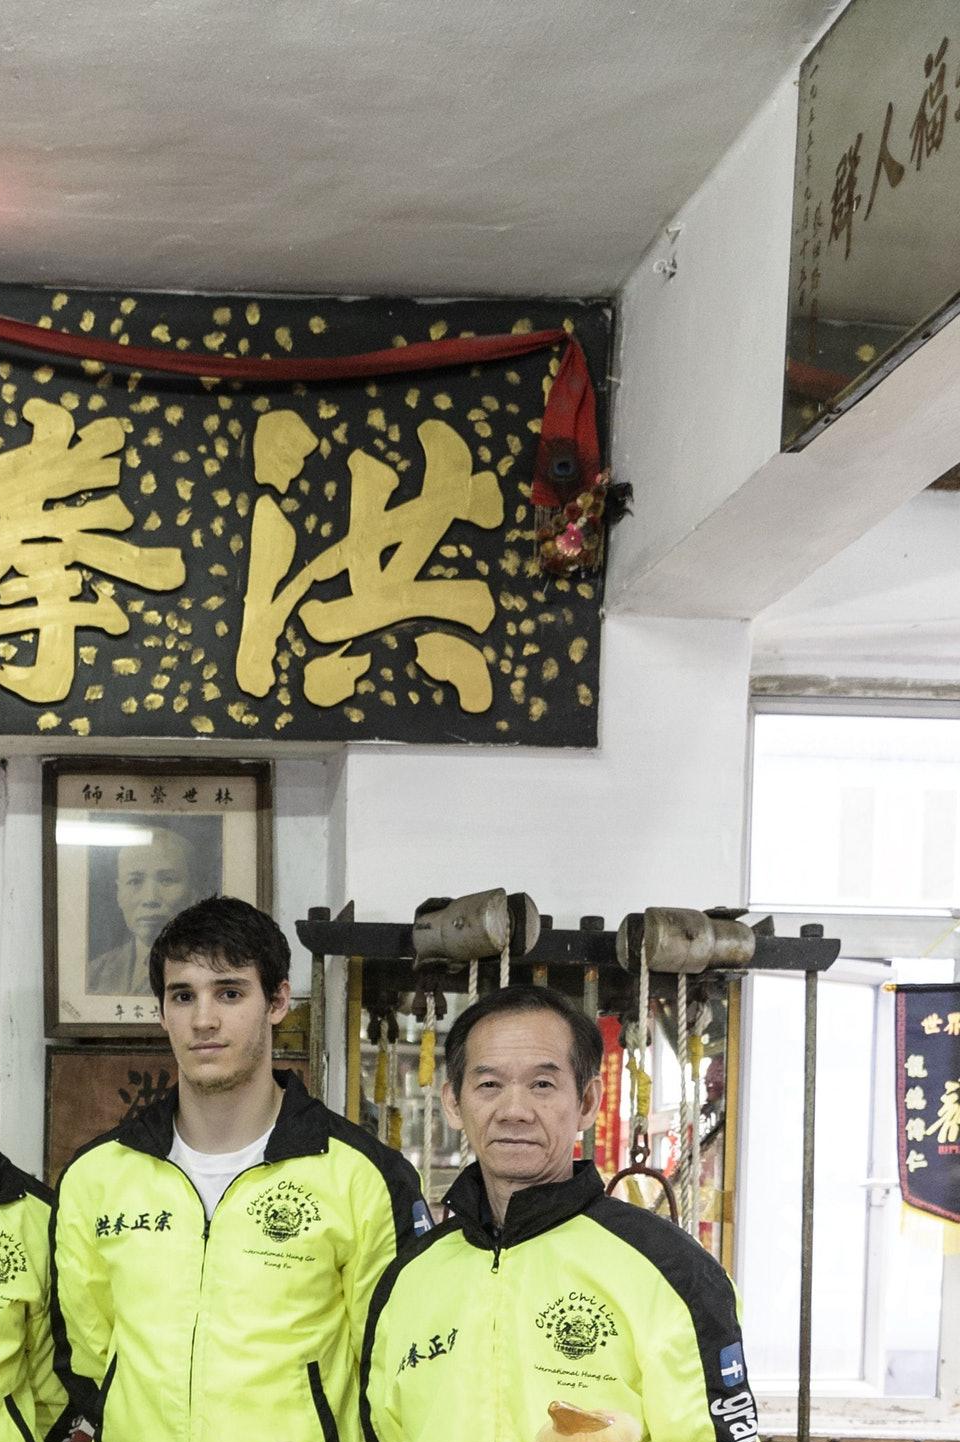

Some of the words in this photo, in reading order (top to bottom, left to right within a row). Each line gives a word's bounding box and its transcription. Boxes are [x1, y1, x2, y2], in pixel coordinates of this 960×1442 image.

[246, 1187, 273, 1215] Chiu
[277, 1181, 304, 1193] Chi
[305, 1193, 321, 1221] Ling
[95, 1210, 173, 1238] 洪拳正宗
[535, 1296, 564, 1329] Chiu
[568, 1291, 598, 1305] Chi
[598, 1304, 619, 1337] Ling
[556, 1379, 576, 1389] Kung
[581, 1370, 602, 1381] Hung
